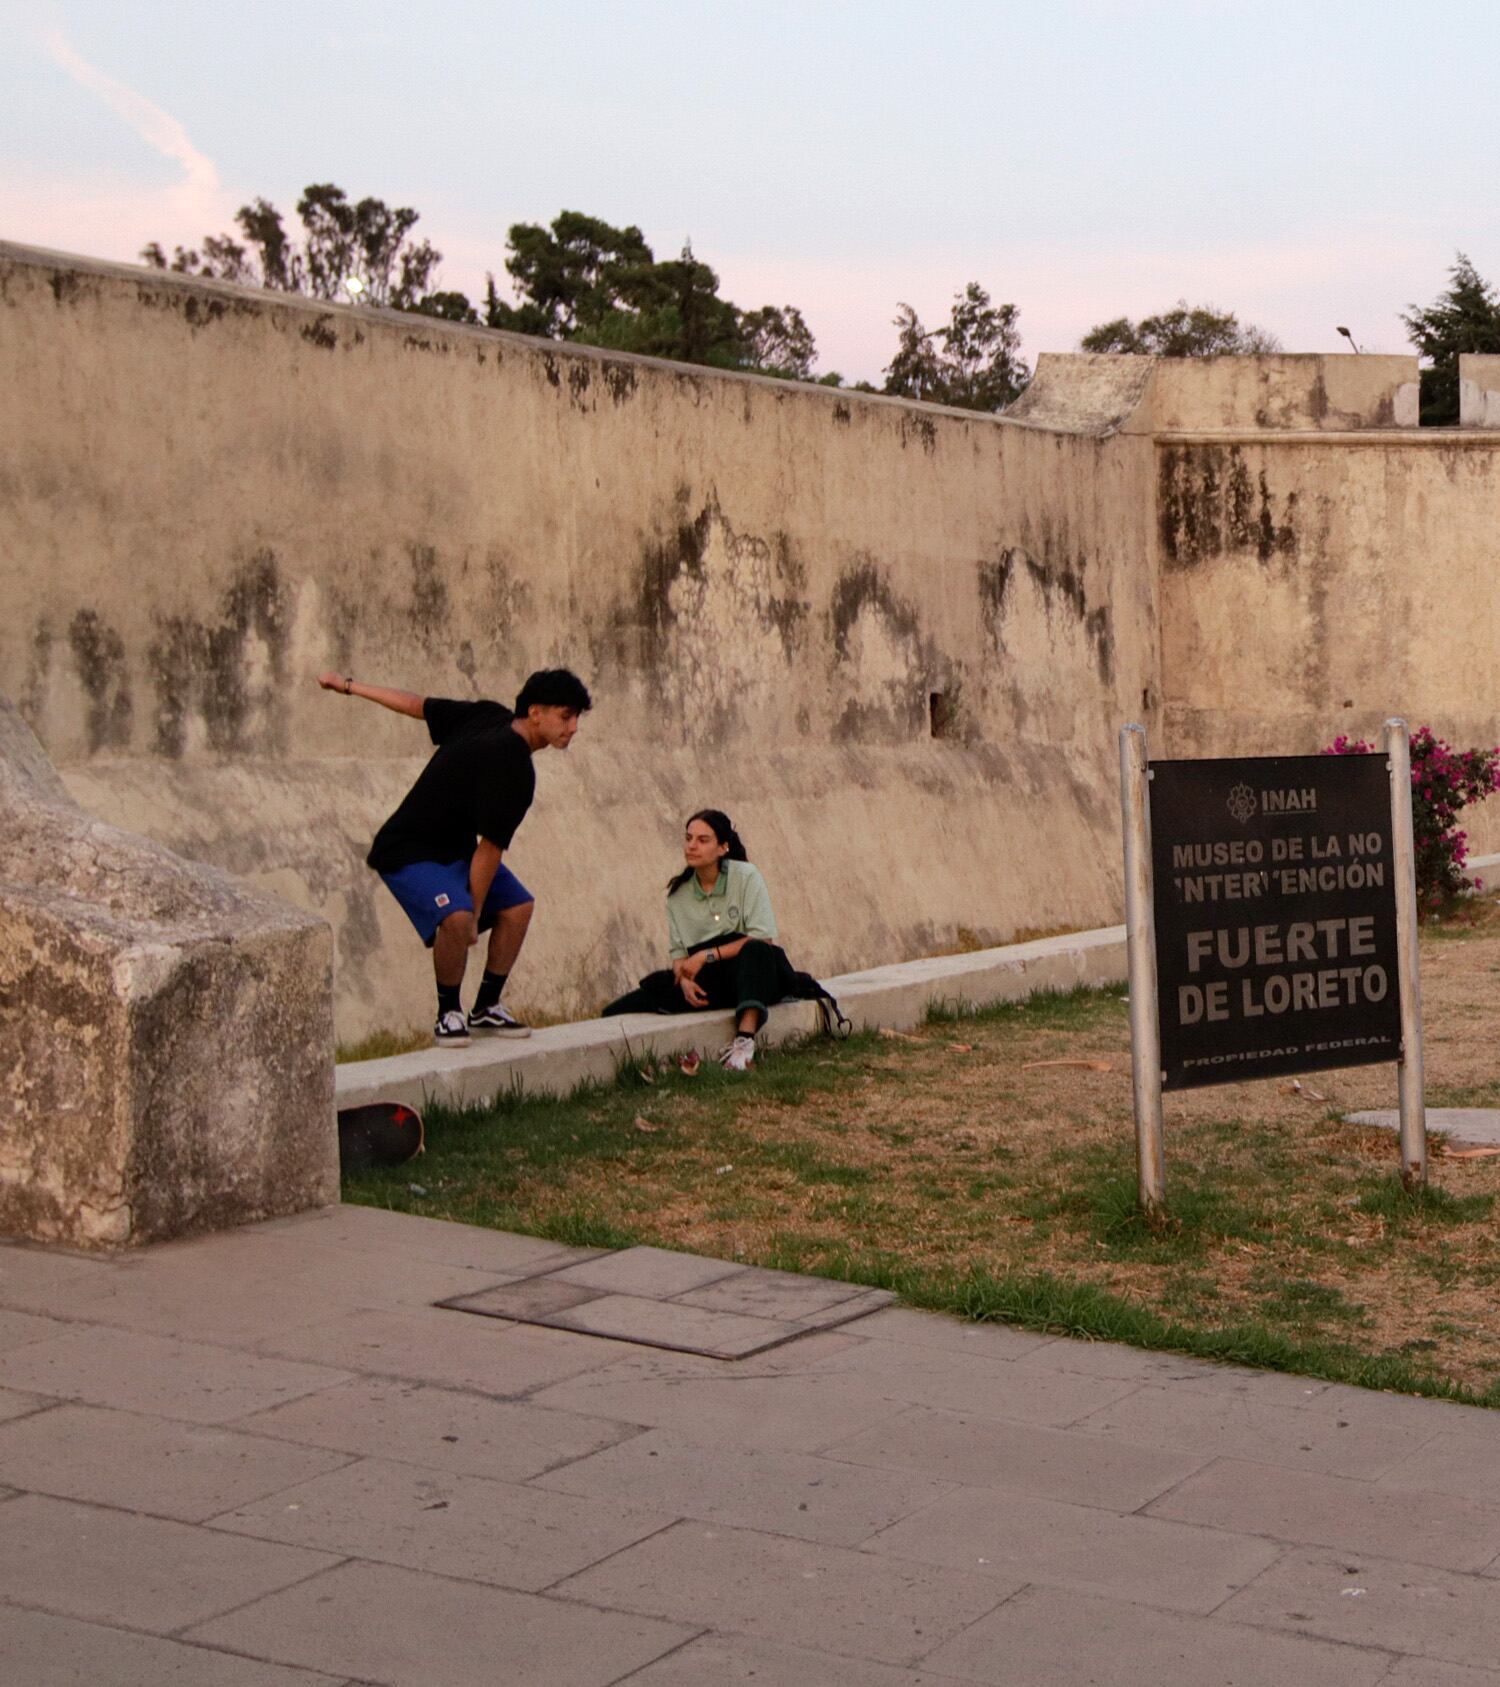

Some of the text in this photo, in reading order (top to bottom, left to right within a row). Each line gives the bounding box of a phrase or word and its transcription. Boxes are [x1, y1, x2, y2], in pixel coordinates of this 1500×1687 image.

[1262, 788, 1317, 811] INAH
[1172, 832, 1383, 868] MUSEO DE LA NO
[1174, 858, 1385, 903] NTERENCIÓN
[1187, 916, 1376, 973] FUERTE
[1178, 964, 1388, 1025] DE LORETO
[1182, 1035, 1392, 1068] PROPIEDAD FEDERAL
